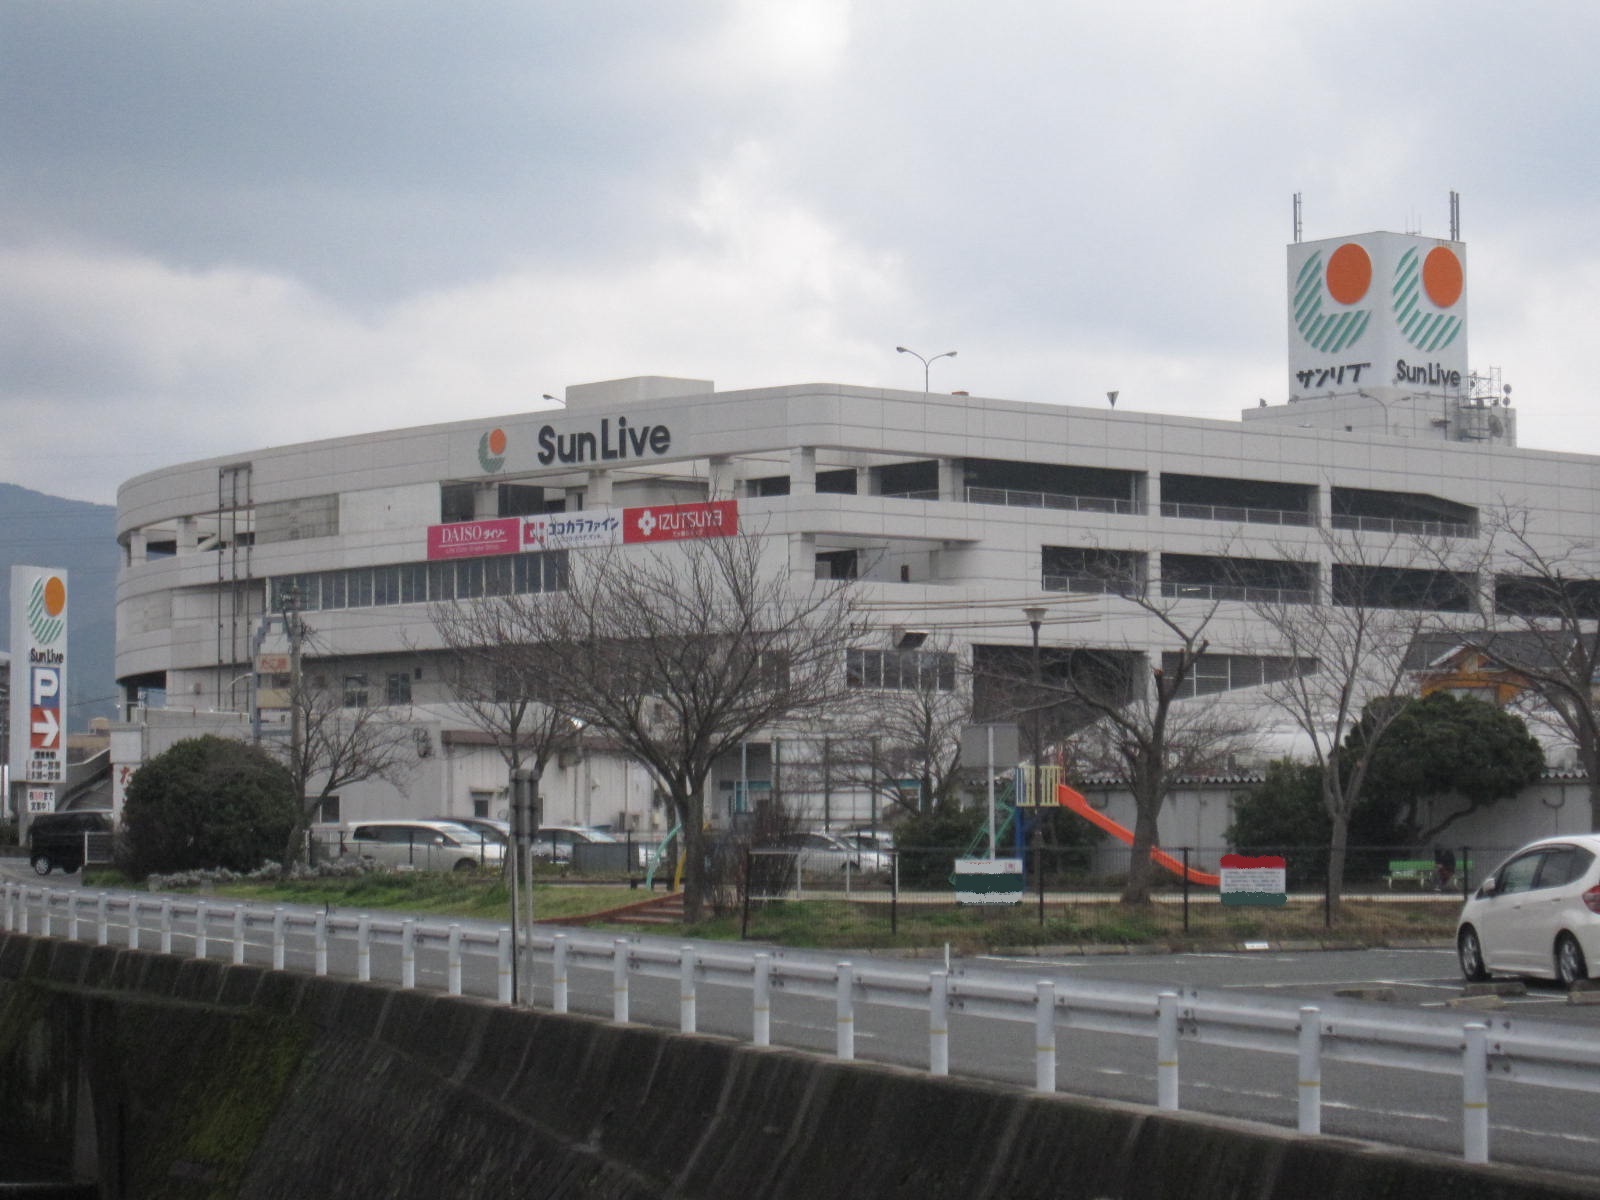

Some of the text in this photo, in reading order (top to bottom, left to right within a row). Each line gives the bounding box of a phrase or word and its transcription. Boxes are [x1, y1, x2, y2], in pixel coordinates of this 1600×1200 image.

[537, 416, 671, 465] SunLive
[442, 525, 482, 543] DAISO
[548, 517, 619, 535] ココカラファイン
[34, 669, 59, 706] P
